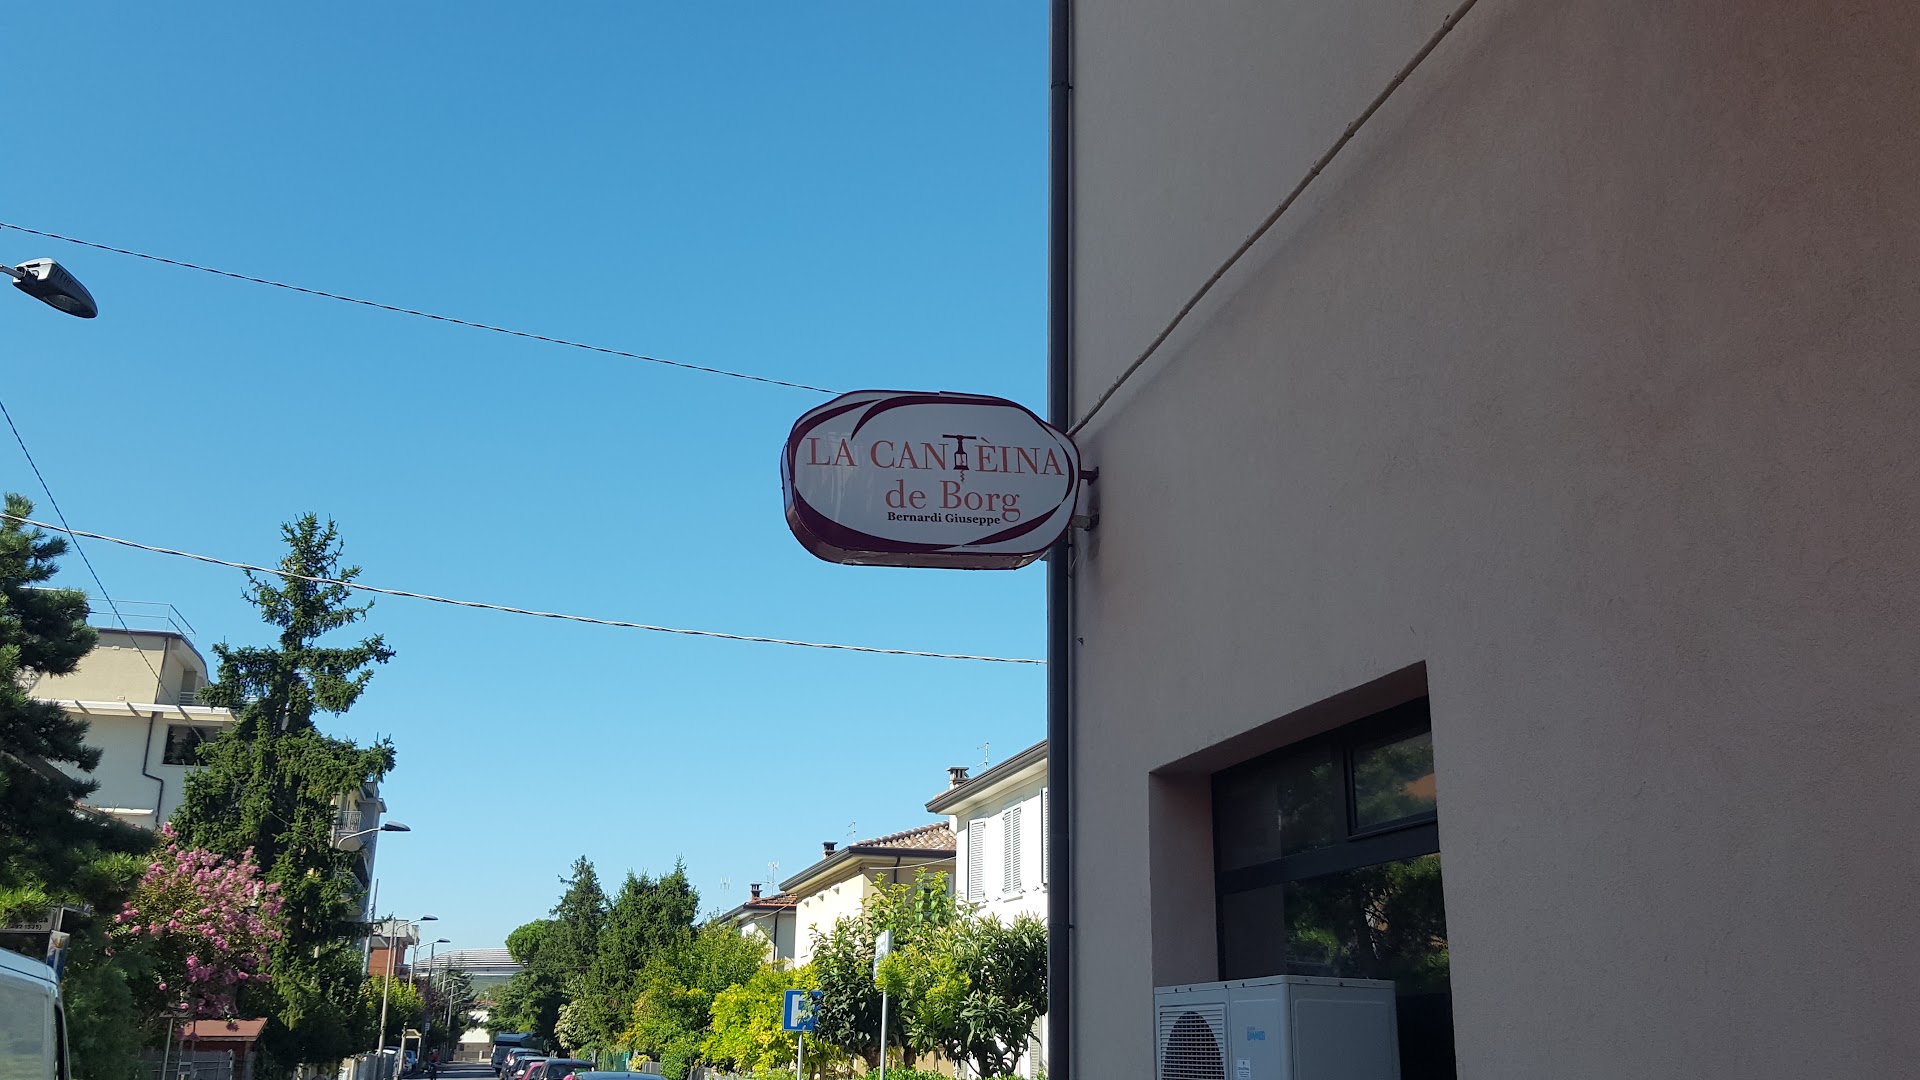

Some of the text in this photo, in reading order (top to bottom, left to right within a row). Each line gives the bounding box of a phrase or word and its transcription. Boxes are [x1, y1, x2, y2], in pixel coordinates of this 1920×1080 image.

[806, 437, 858, 467] LA
[885, 478, 1021, 522] de Borg
[887, 511, 1001, 526] Bernardi Giuseppe
